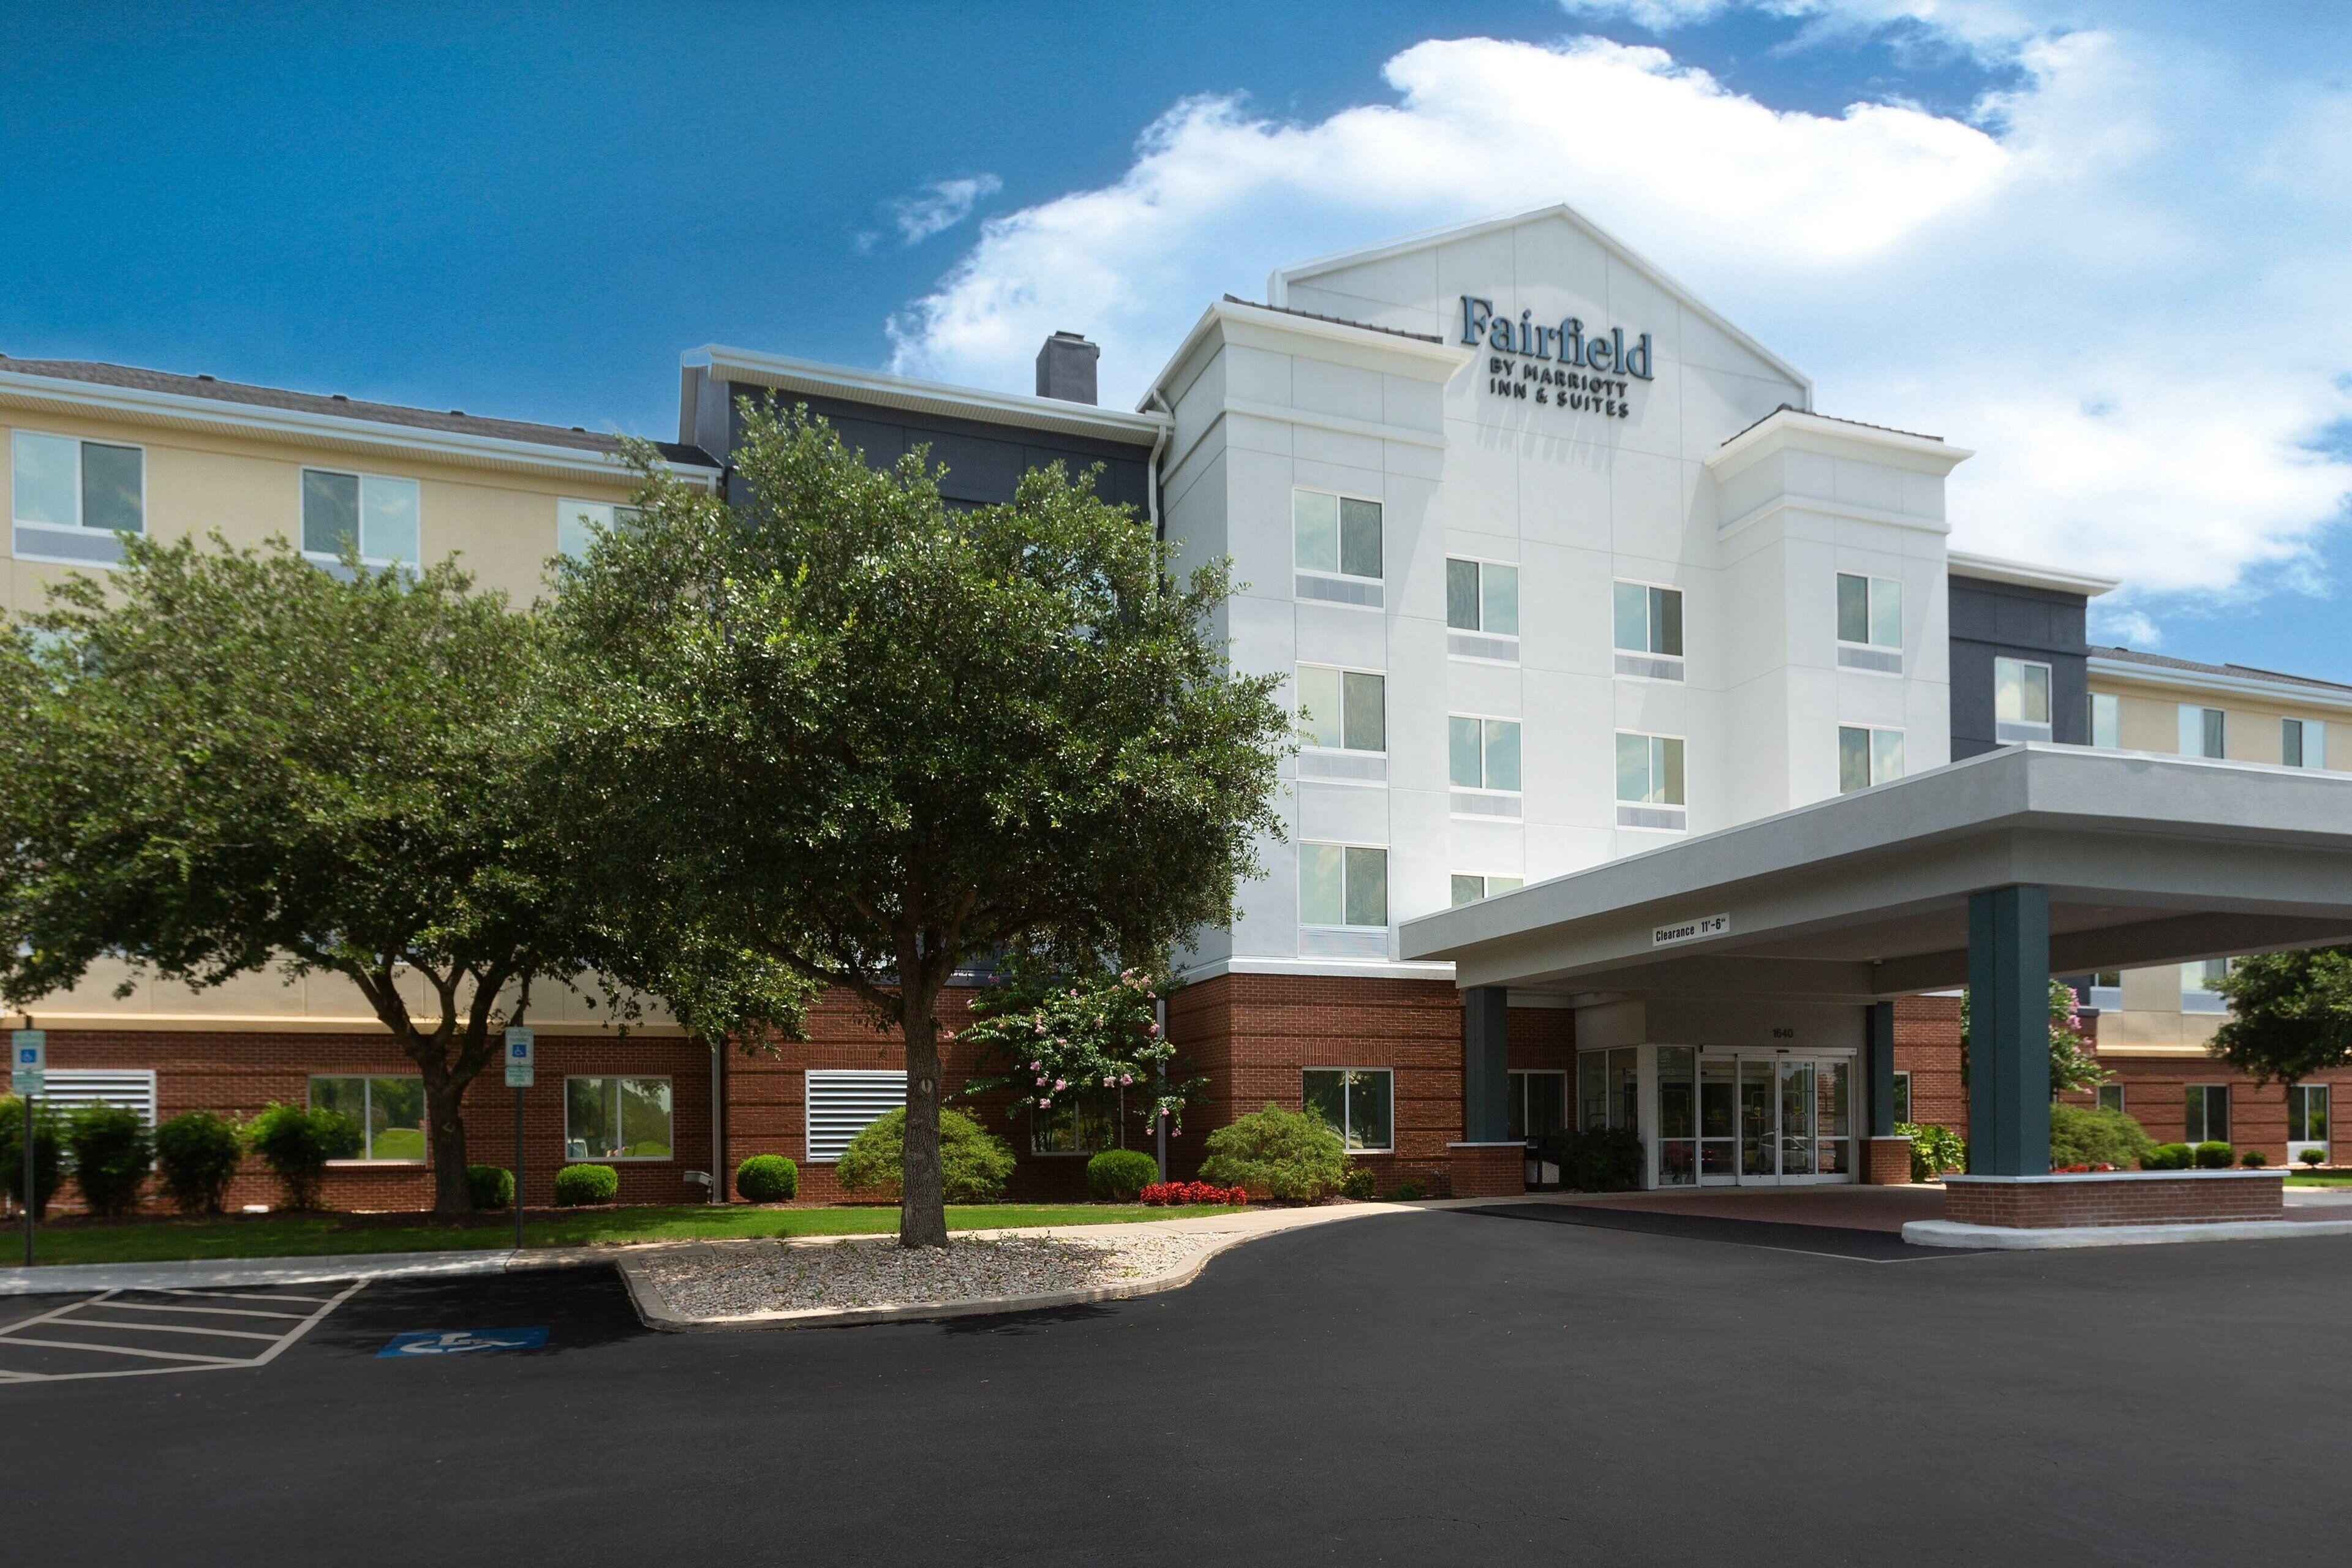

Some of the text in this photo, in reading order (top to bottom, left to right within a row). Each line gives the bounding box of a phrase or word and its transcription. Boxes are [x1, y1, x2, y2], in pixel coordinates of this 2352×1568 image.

[1460, 295, 1654, 381] Fairfield
[1490, 356, 1629, 398] BY MARRIOTT
[1490, 377, 1629, 419] INN & SUITES
[1656, 926, 1694, 941] Clearance
[1773, 1028, 1793, 1038] 1640
